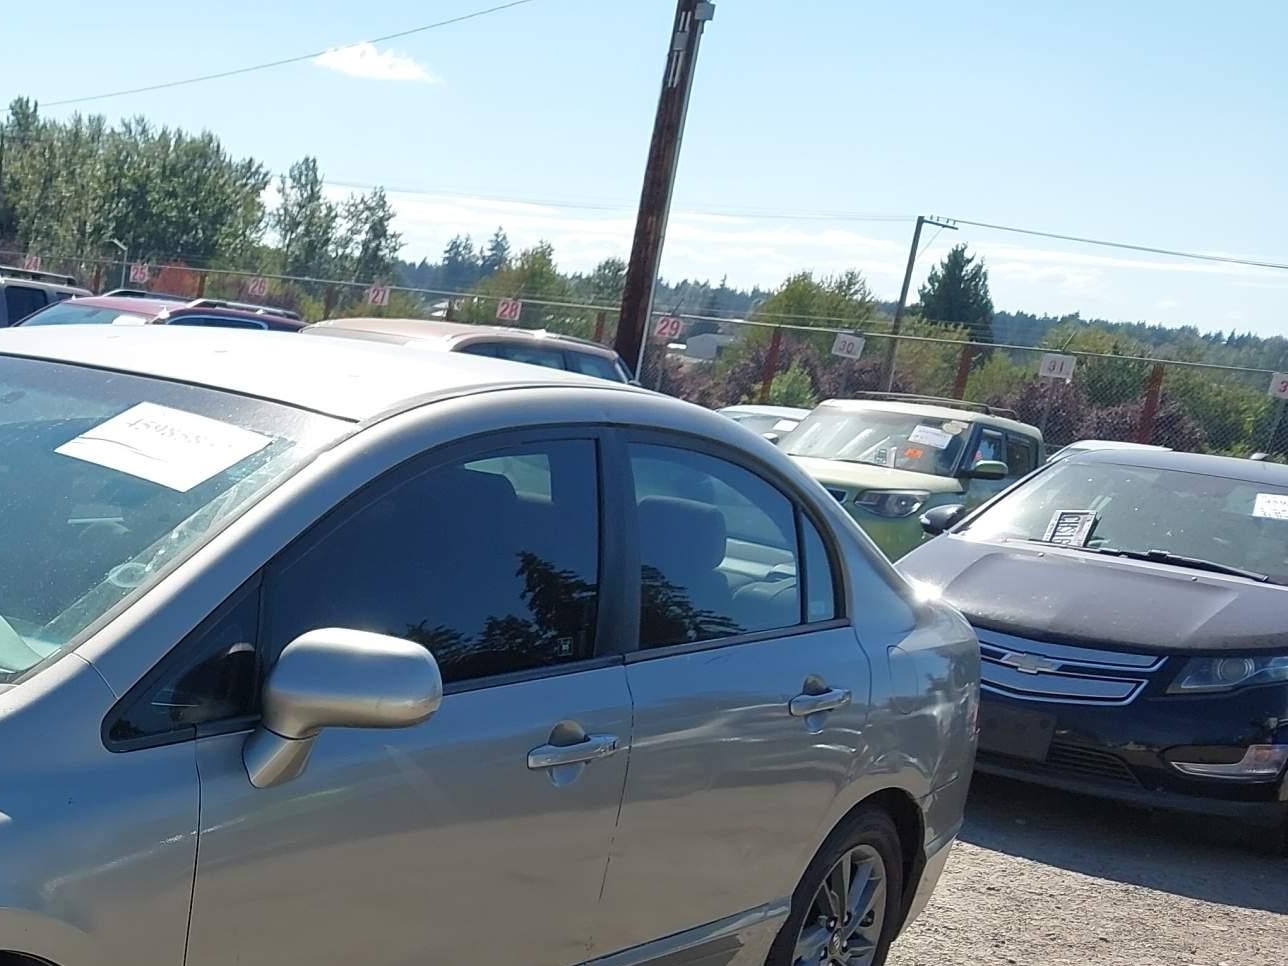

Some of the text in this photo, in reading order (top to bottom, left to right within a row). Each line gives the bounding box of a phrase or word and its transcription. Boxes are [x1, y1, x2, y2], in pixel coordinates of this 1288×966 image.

[371, 288, 386, 304] 27
[499, 302, 519, 319] 28
[657, 317, 680, 337] 29
[839, 340, 856, 354] 30
[1049, 360, 1065, 373] 31
